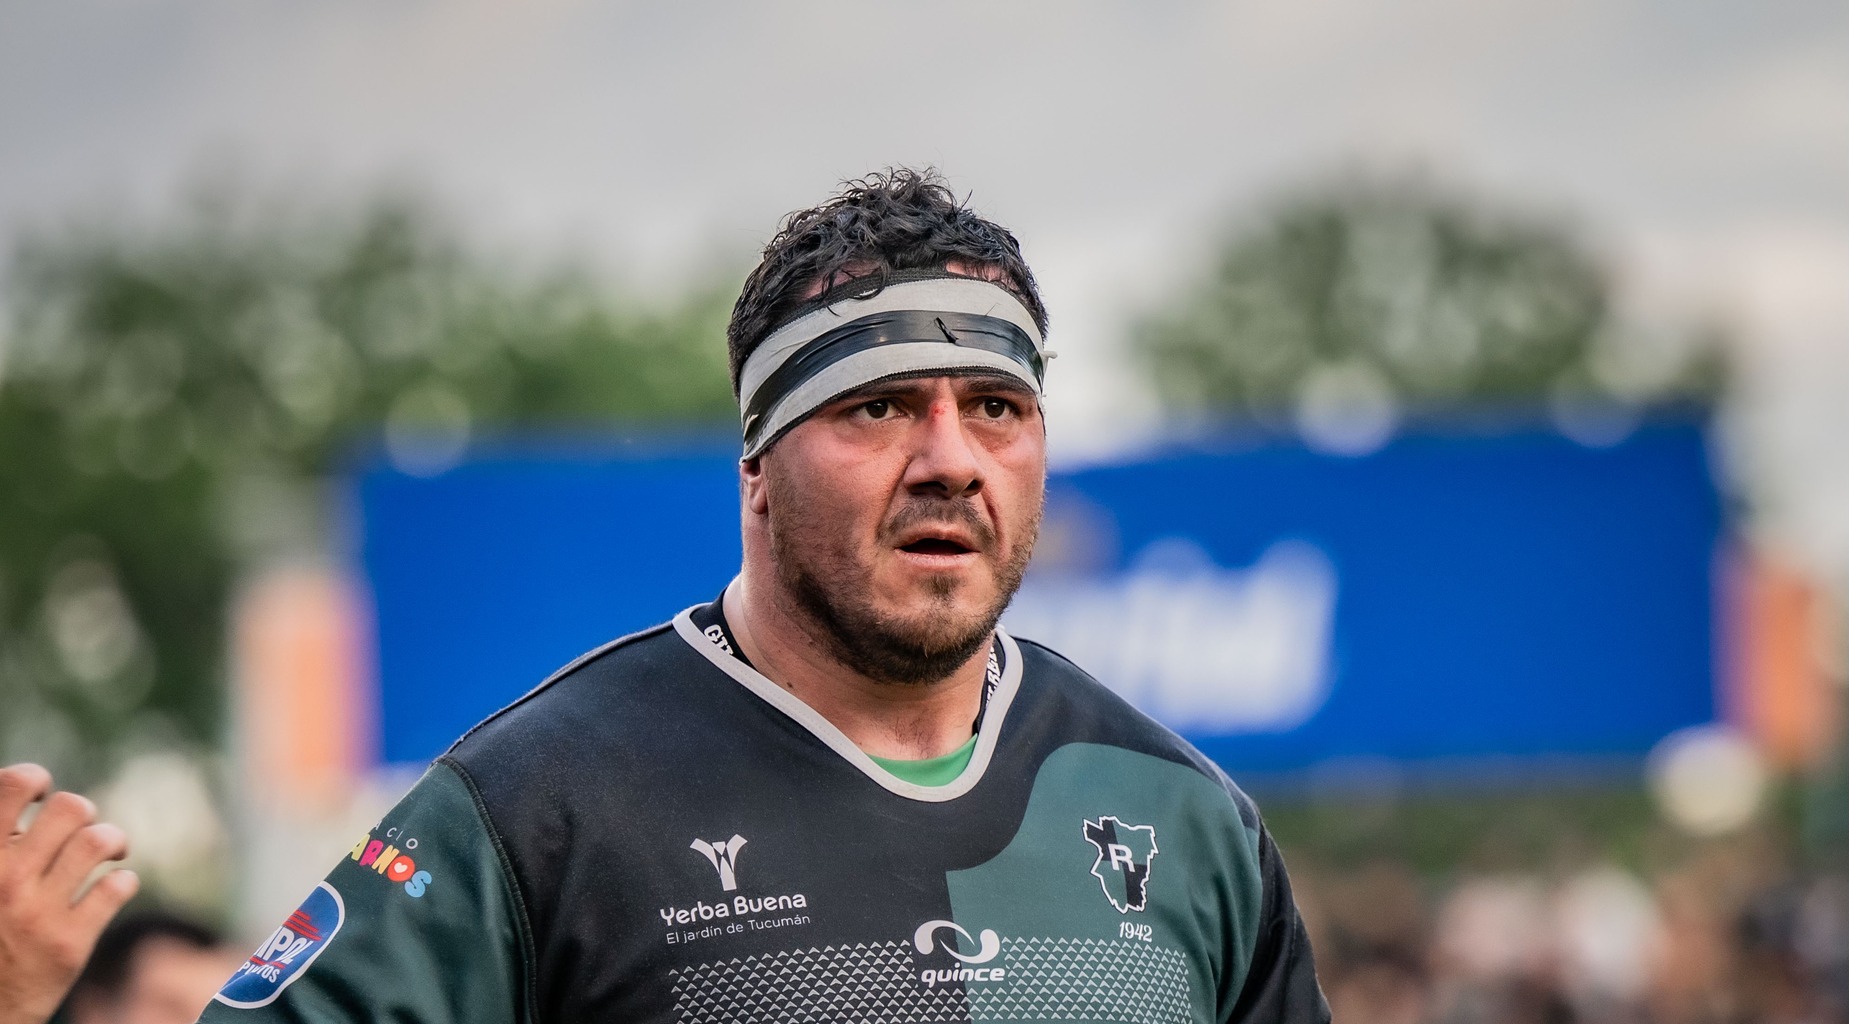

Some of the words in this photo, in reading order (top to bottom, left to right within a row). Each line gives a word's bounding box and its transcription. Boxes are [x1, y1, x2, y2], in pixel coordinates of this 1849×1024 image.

[1108, 843, 1136, 873] R
[660, 901, 730, 926] Yerba
[733, 893, 808, 915] Buena
[666, 932, 680, 944] El
[683, 925, 723, 943] jardín
[726, 922, 744, 934] de
[747, 914, 811, 931] Tucumán
[1119, 921, 1153, 943] 1942
[921, 962, 1006, 989] quince
